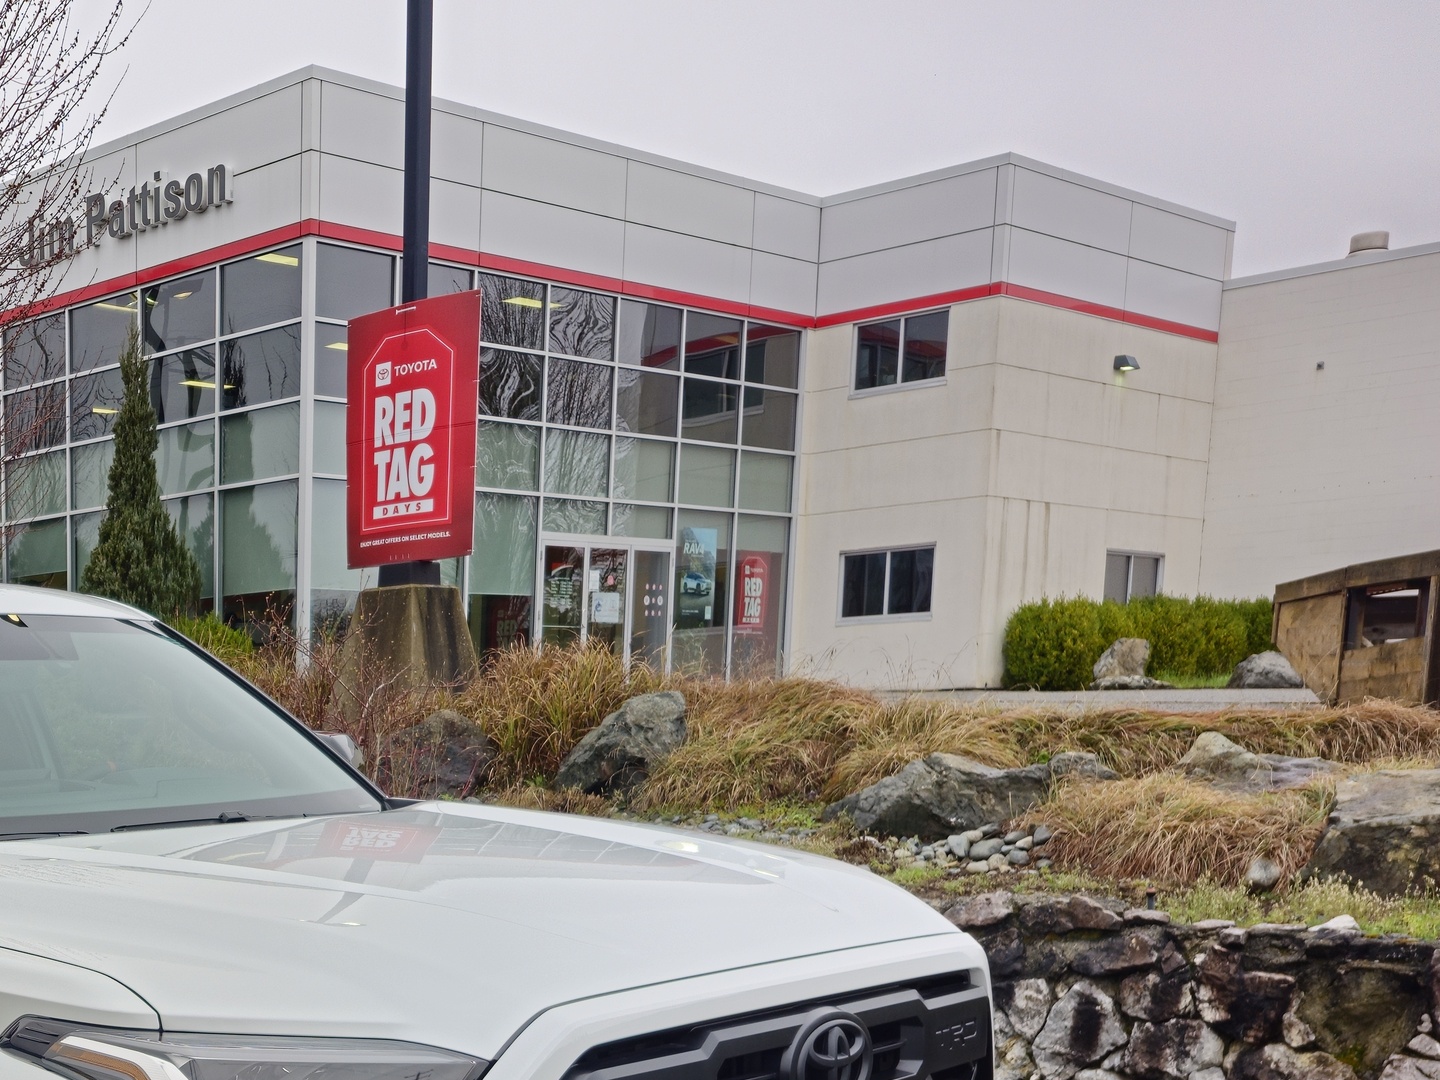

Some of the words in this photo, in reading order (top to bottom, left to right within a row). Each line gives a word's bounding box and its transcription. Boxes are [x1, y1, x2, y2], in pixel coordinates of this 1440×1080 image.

[19, 213, 74, 267] Jim
[86, 163, 229, 245] Pattison
[394, 358, 438, 377] TOYOTA
[374, 388, 436, 448] RED
[374, 443, 435, 503] TAG
[382, 502, 422, 516] DAYS
[385, 536, 401, 544] OFFERS
[410, 533, 427, 541] SELECT
[427, 531, 451, 539] MODELS.
[683, 542, 705, 555] RAV4
[744, 577, 762, 597] RED
[744, 597, 761, 617] TAG
